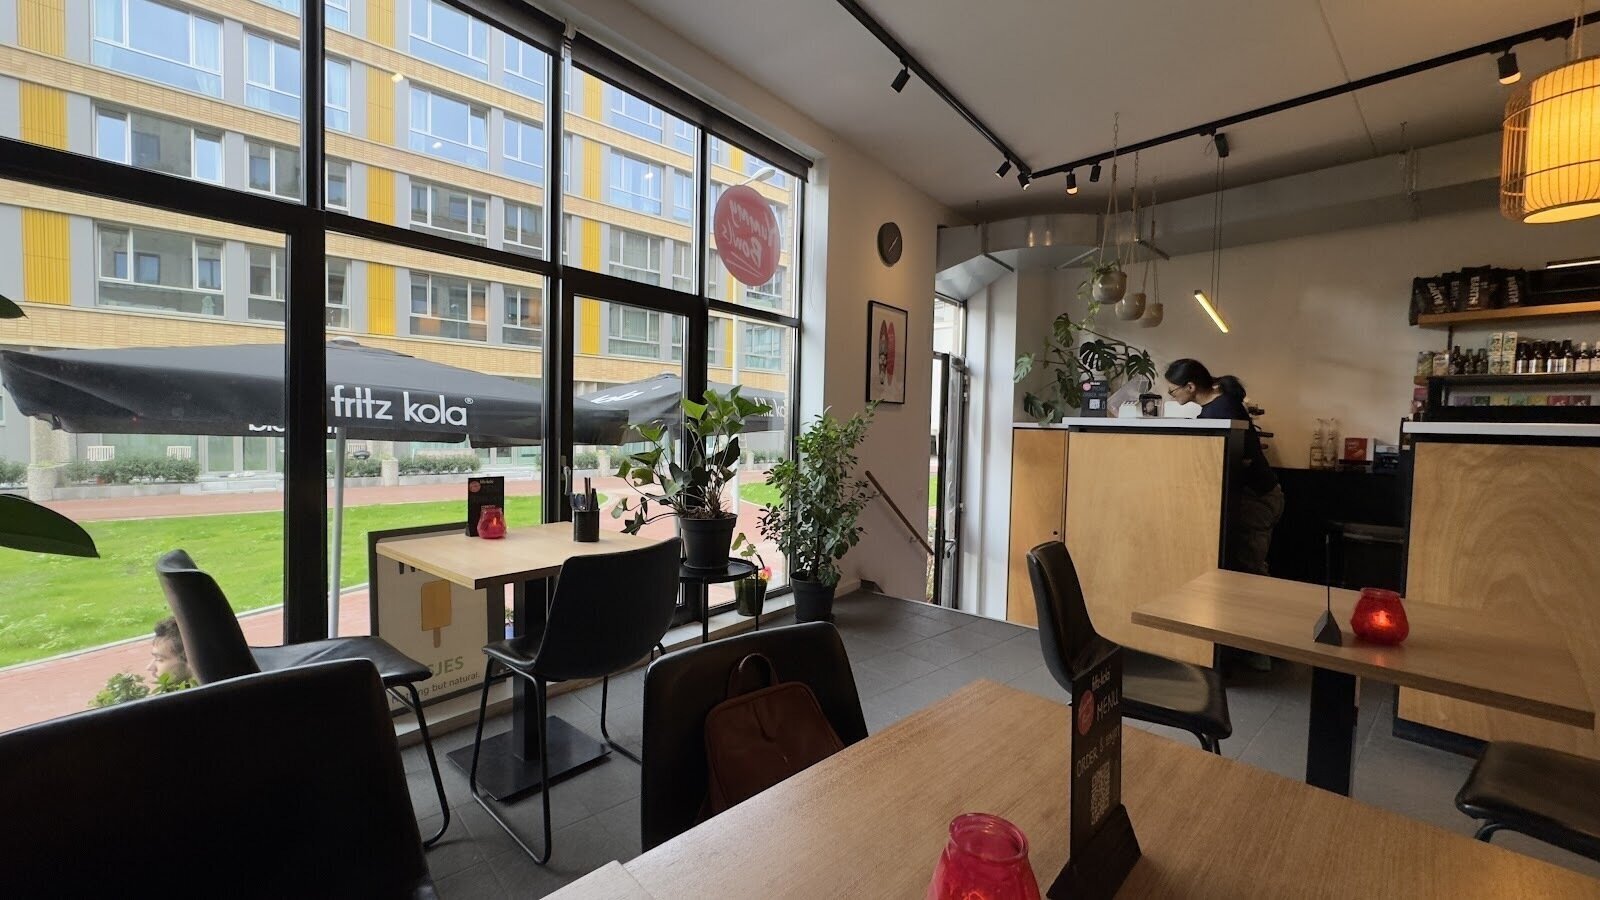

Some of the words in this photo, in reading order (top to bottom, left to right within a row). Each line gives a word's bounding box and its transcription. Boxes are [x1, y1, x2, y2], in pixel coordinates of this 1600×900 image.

[330, 384, 393, 420] fritz
[431, 681, 447, 692] but
[1096, 688, 1119, 721] MENU
[1076, 746, 1098, 777] ORDER
